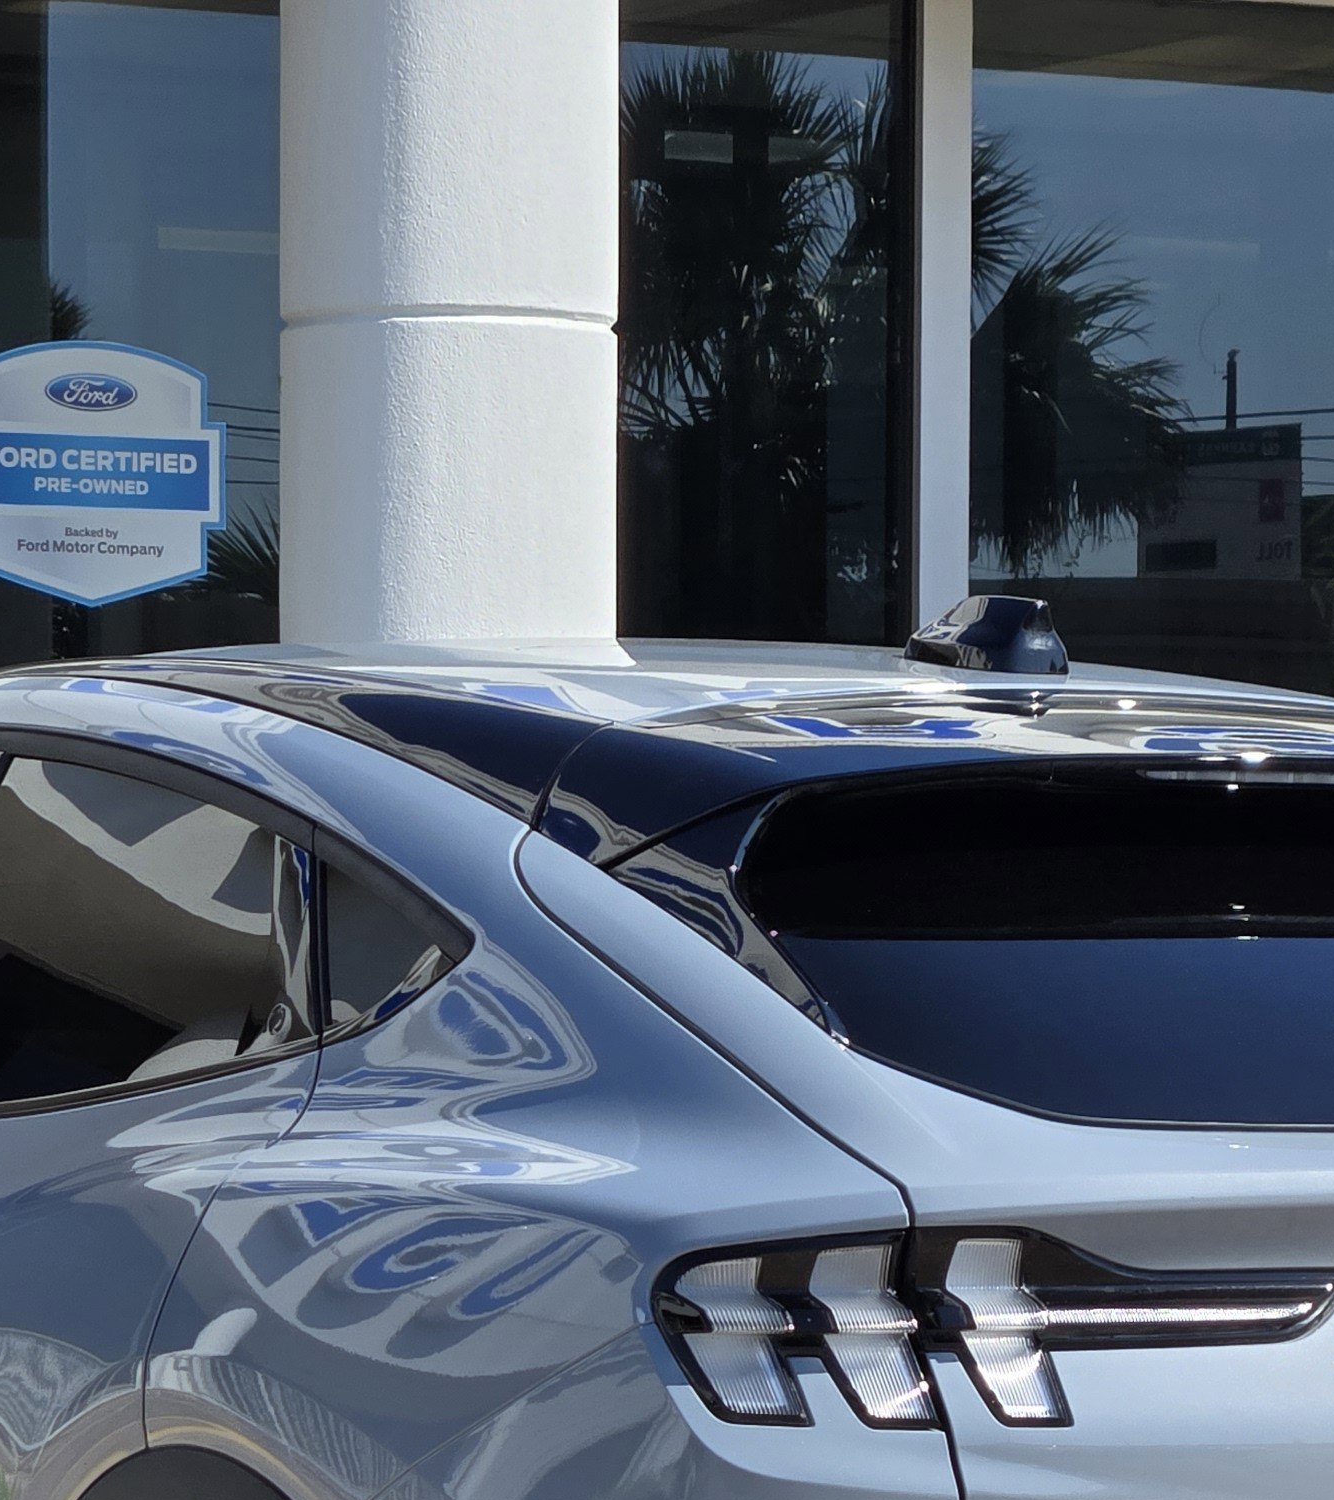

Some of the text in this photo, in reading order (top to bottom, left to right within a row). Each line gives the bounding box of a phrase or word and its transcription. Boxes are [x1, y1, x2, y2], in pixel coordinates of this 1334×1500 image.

[63, 377, 119, 406] Ford
[61, 449, 198, 474] CERTIFIED
[33, 476, 149, 496] PRE-OWNED
[64, 526, 119, 540] Backed by
[17, 538, 165, 557] Ford Motor Company
